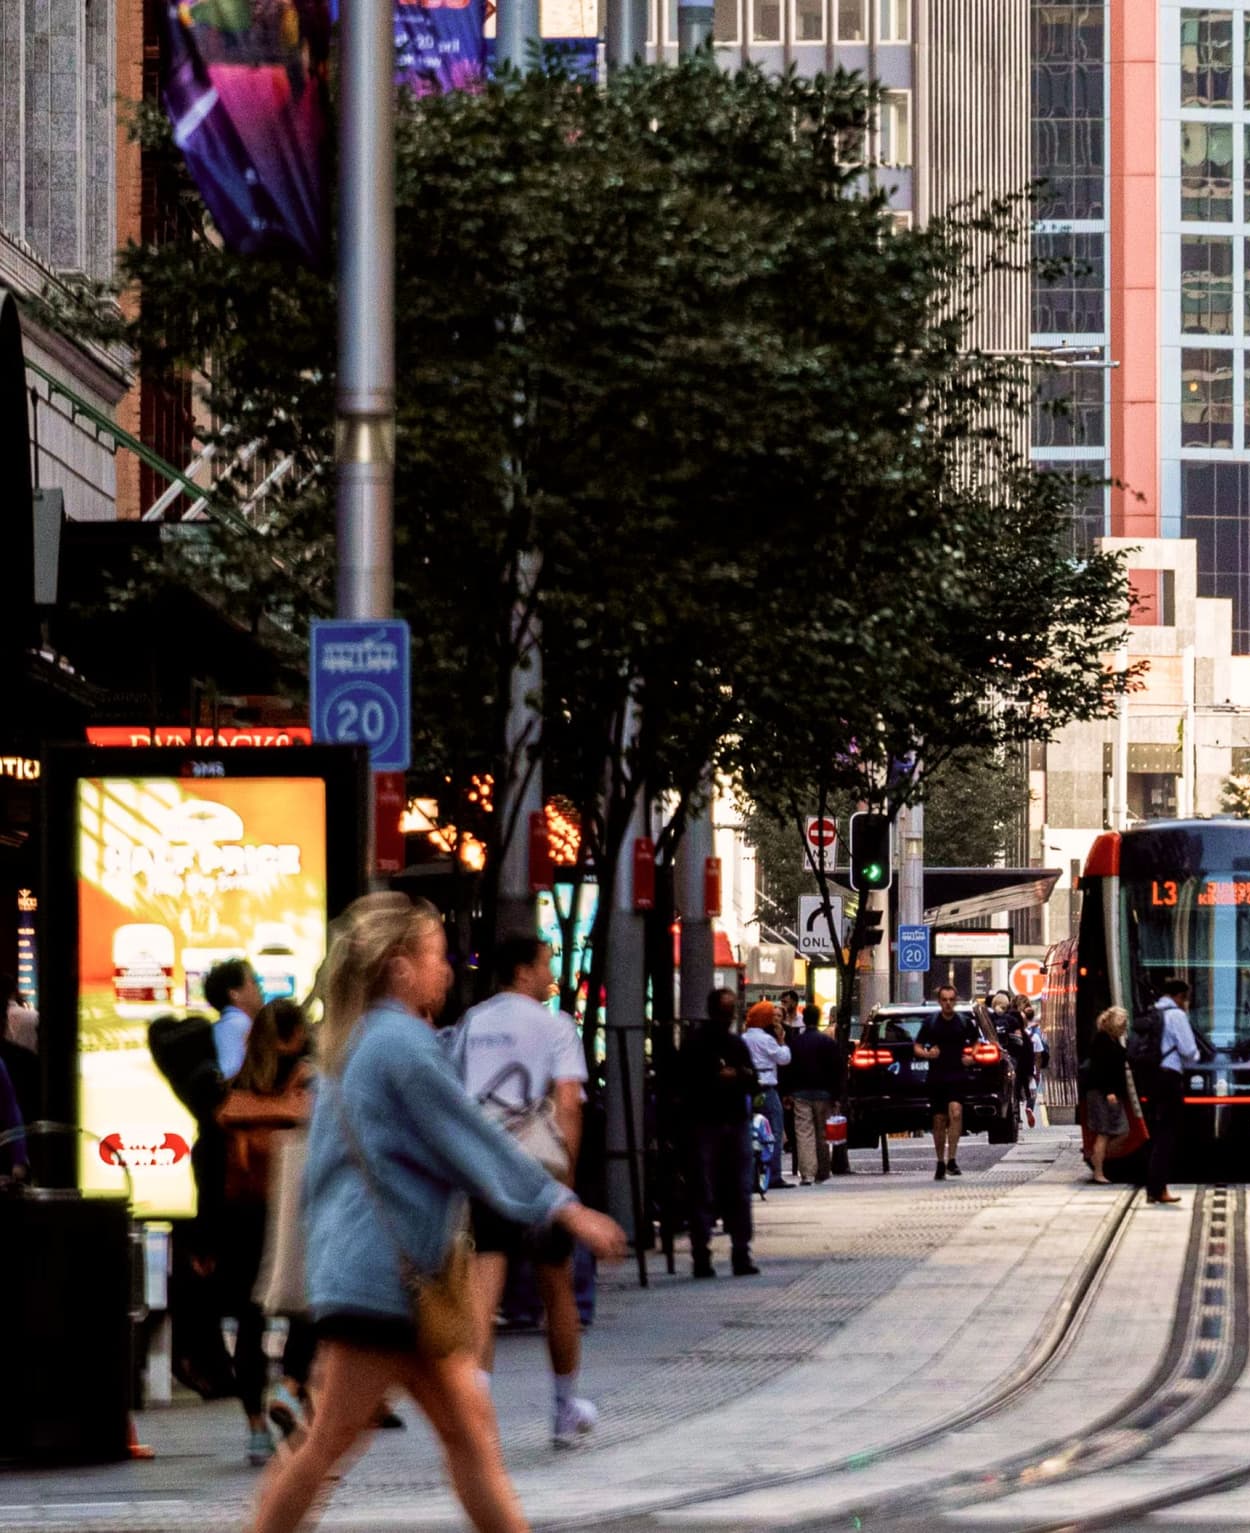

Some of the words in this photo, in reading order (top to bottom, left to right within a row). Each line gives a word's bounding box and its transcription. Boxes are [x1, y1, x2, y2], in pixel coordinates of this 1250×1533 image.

[337, 700, 384, 741] 20
[1152, 881, 1178, 905] L3
[802, 937, 830, 948] ONL
[906, 949, 922, 962] 20
[1021, 969, 1039, 993] T
